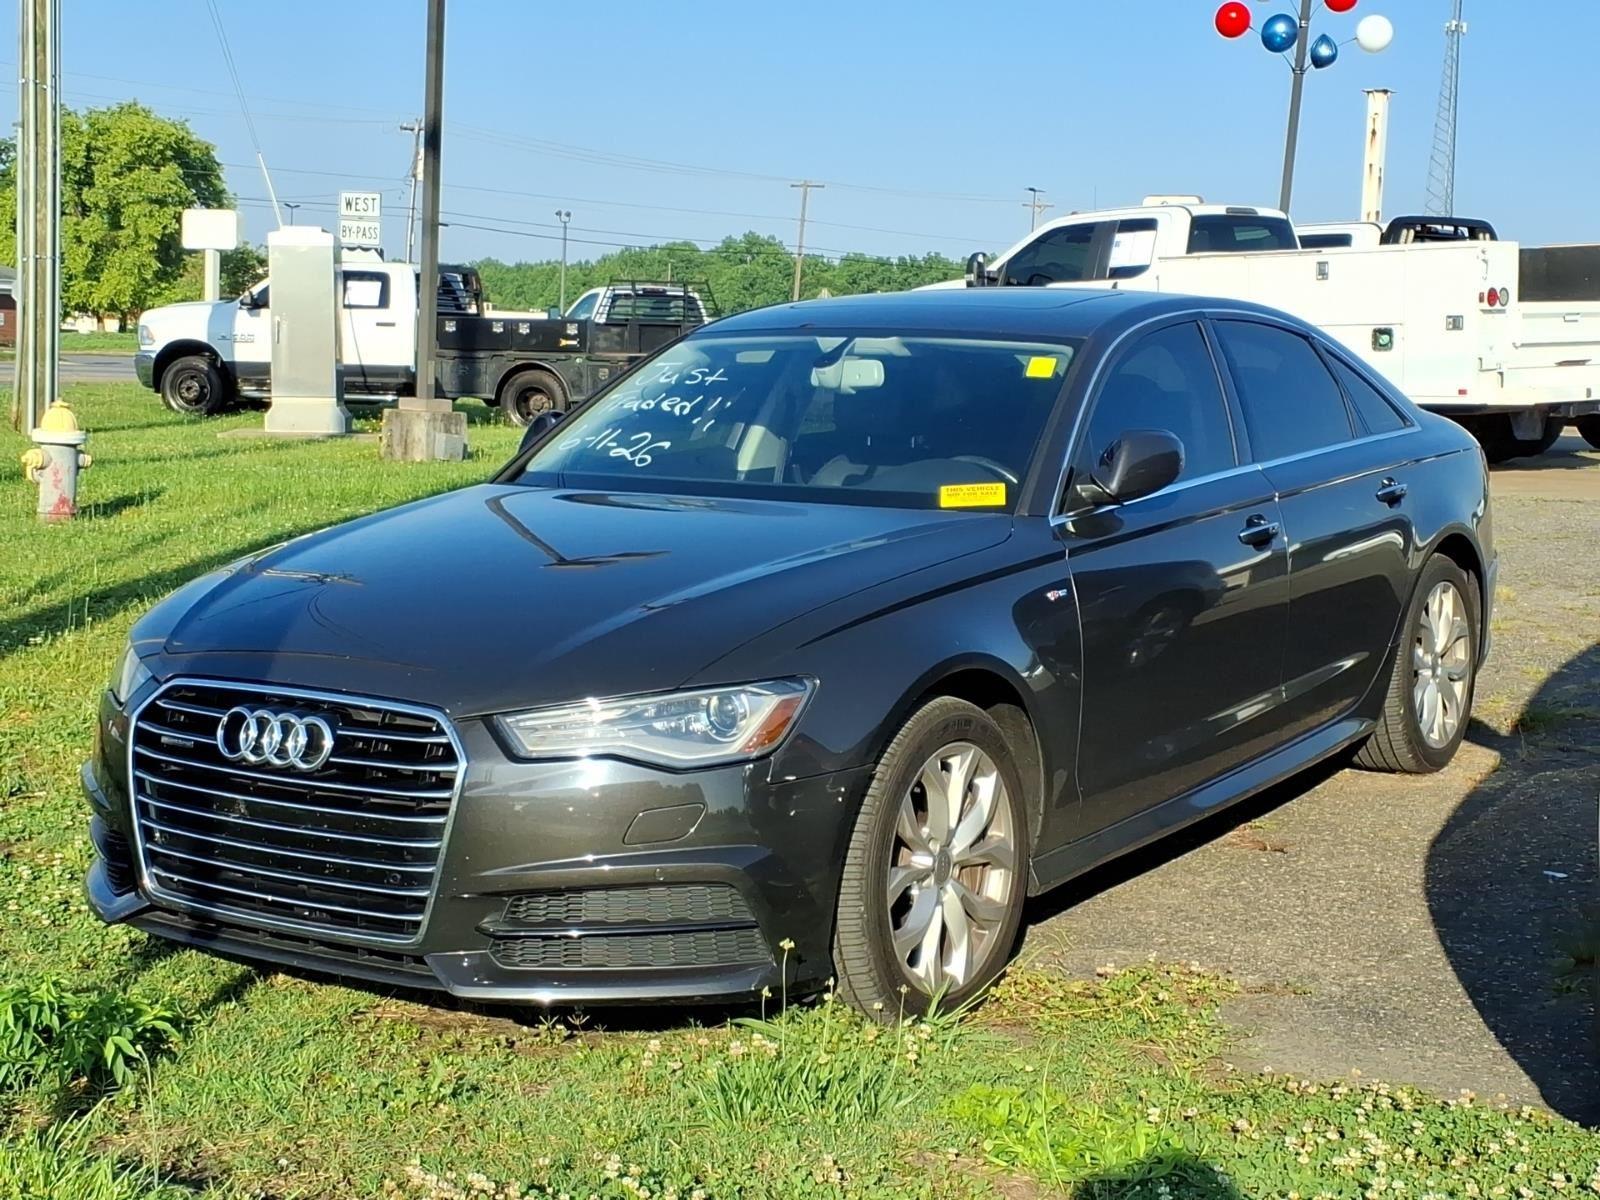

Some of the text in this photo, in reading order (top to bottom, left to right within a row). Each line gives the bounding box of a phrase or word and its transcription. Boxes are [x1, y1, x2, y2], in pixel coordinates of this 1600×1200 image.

[344, 197, 377, 212] WEST
[341, 225, 378, 240] BY-PASS
[636, 362, 728, 386] Just
